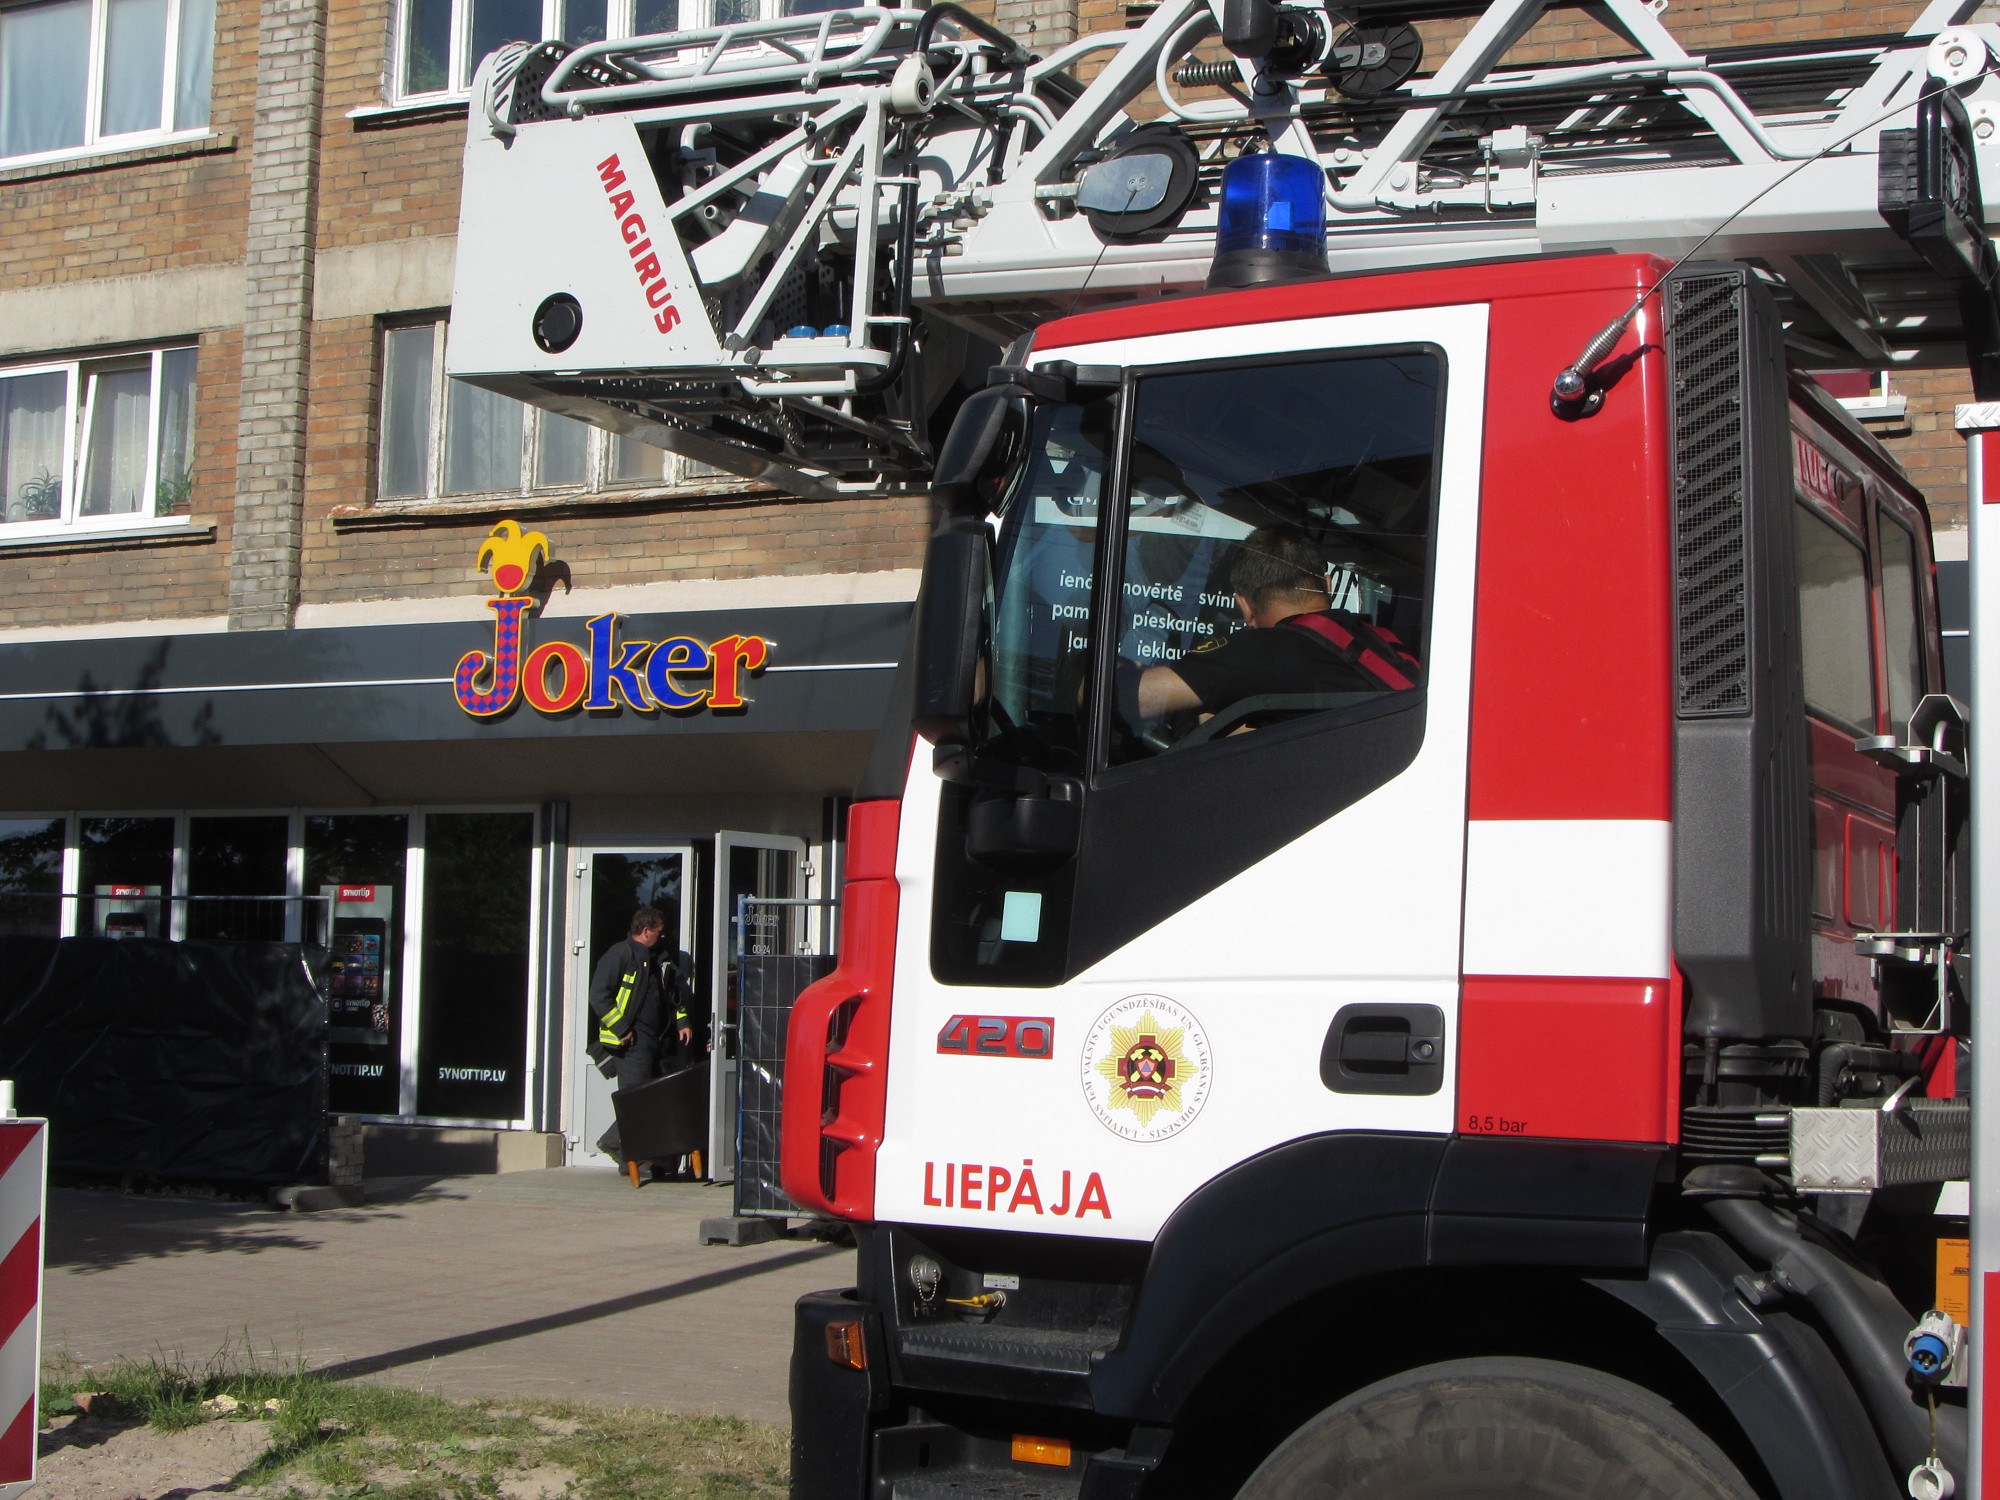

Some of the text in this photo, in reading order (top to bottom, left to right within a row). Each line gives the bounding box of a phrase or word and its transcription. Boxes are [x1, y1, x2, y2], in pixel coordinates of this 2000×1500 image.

[596, 153, 682, 335] MAGIRUS
[1123, 582, 1183, 602] novērtē
[1132, 610, 1214, 635] pieskaries
[453, 597, 767, 717] Joker
[939, 1017, 1052, 1056] 420
[1180, 1015, 1195, 1031] UN
[329, 1063, 384, 1077] NOTTIP.LV
[1083, 1033, 1099, 1074] VALSTS
[438, 1066, 507, 1083] SYNOTTIP.LV
[1095, 1104, 1138, 1139] LATVIJAS
[1150, 1105, 1196, 1139] DIENESTS
[1468, 1115, 1528, 1133] 8,5 bar
[923, 1158, 1113, 1220] LIEPĀJA
